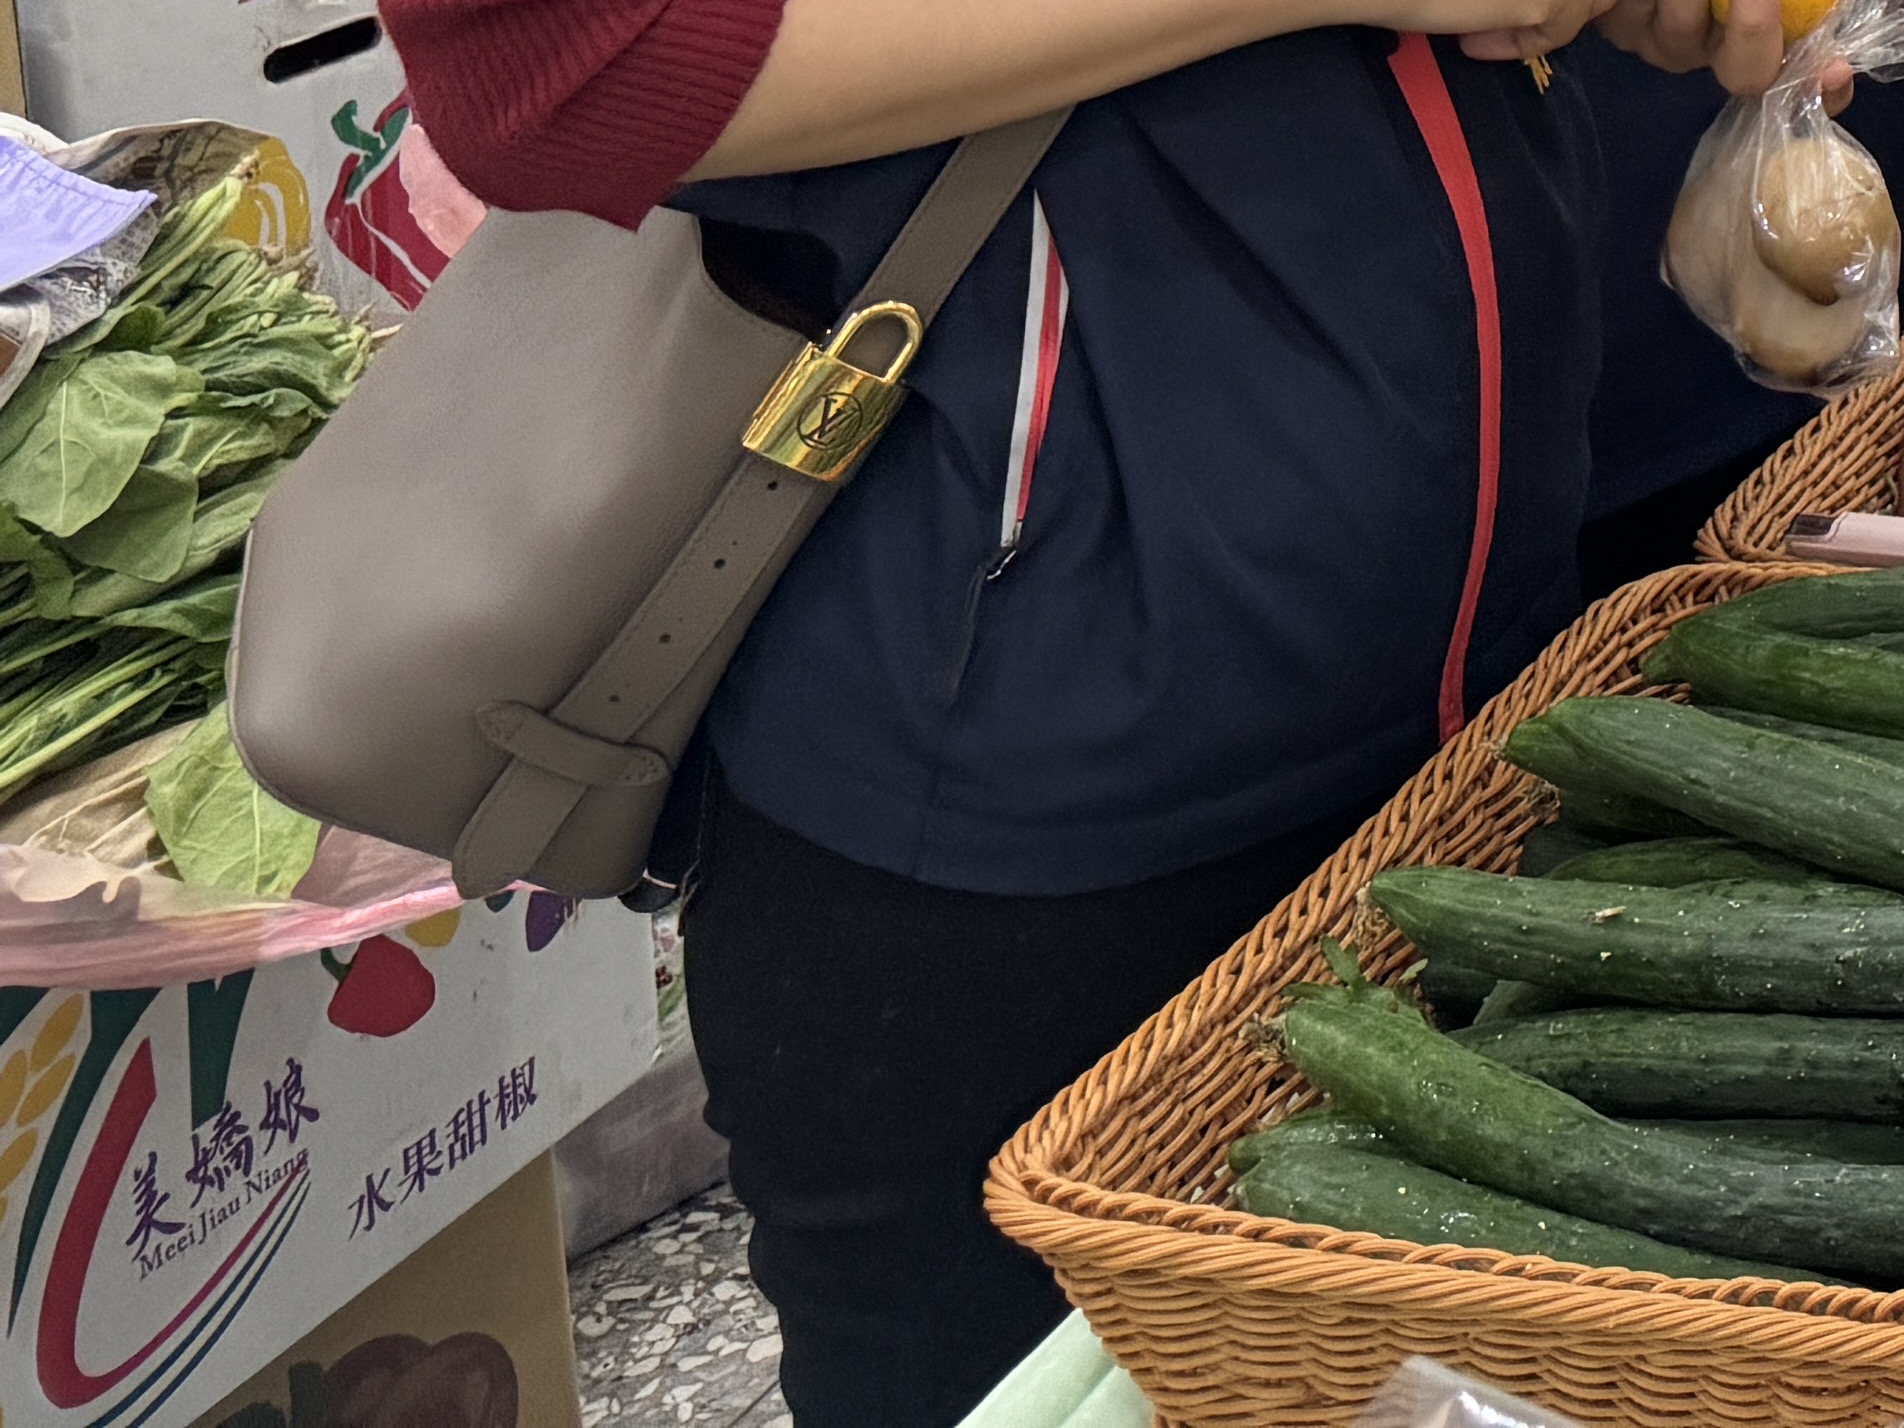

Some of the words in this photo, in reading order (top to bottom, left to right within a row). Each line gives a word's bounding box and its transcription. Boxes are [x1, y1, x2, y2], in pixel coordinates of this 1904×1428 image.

[347, 1055, 538, 1241] 水果甜椒
[139, 1225, 196, 1281] Meei
[199, 1196, 242, 1246] Jiau
